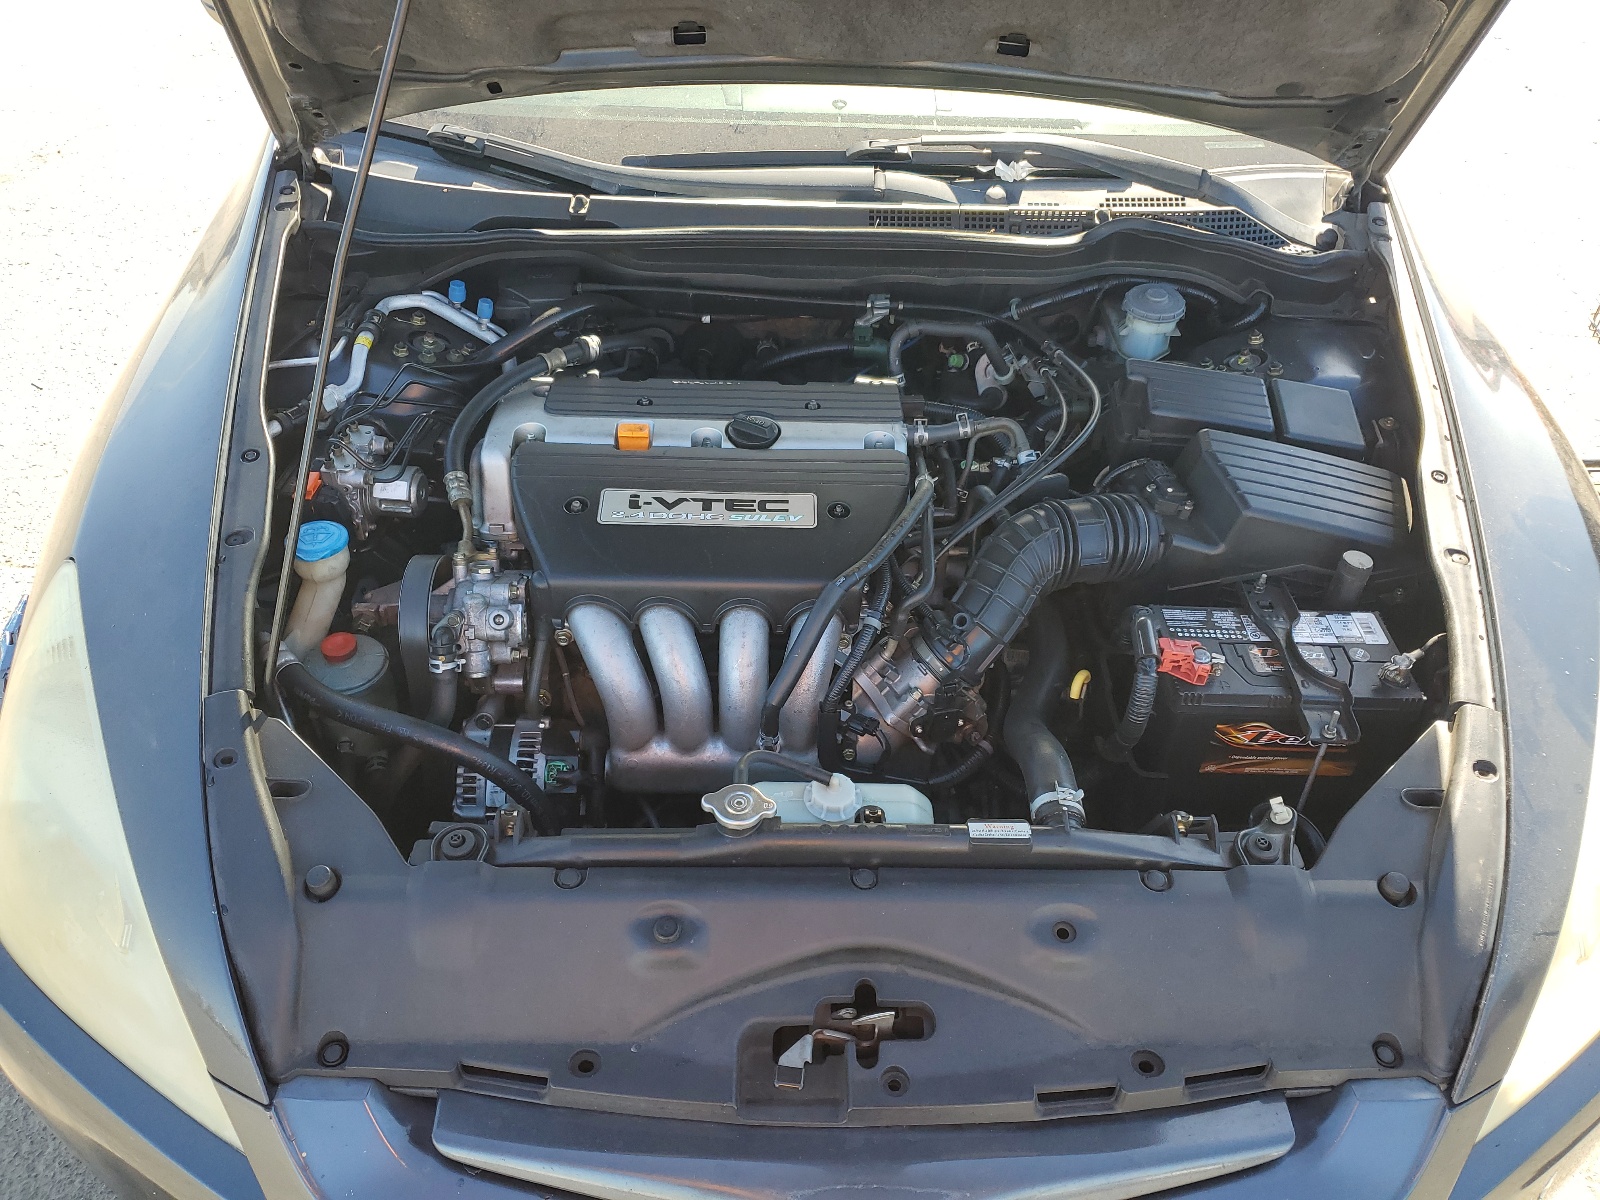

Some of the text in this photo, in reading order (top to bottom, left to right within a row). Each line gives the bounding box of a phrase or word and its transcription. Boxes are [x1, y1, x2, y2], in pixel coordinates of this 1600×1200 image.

[628, 494, 789, 513] i-VTEC
[649, 512, 725, 521] DOHC
[728, 514, 804, 522] SULEV
